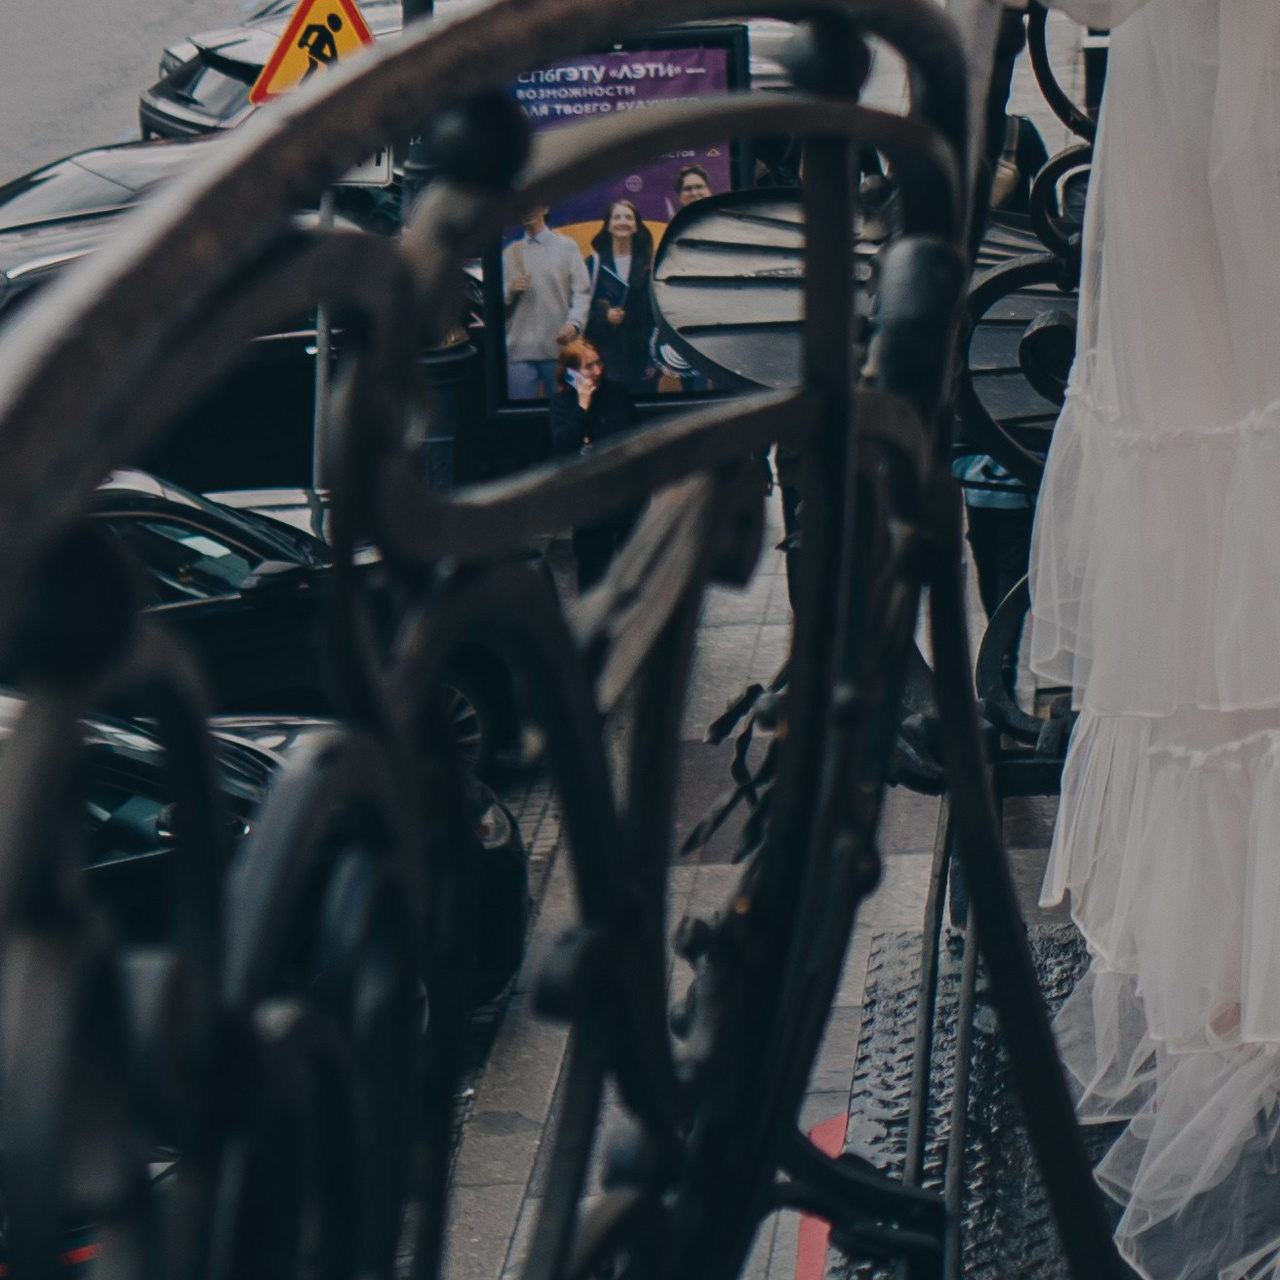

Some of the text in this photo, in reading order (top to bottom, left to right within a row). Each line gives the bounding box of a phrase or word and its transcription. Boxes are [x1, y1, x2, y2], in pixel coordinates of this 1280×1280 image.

[517, 65, 606, 84] СПбГЭТУ
[516, 85, 636, 100] ВОЗМОЖНОСТИ
[554, 101, 612, 115] ТВОЕГО
